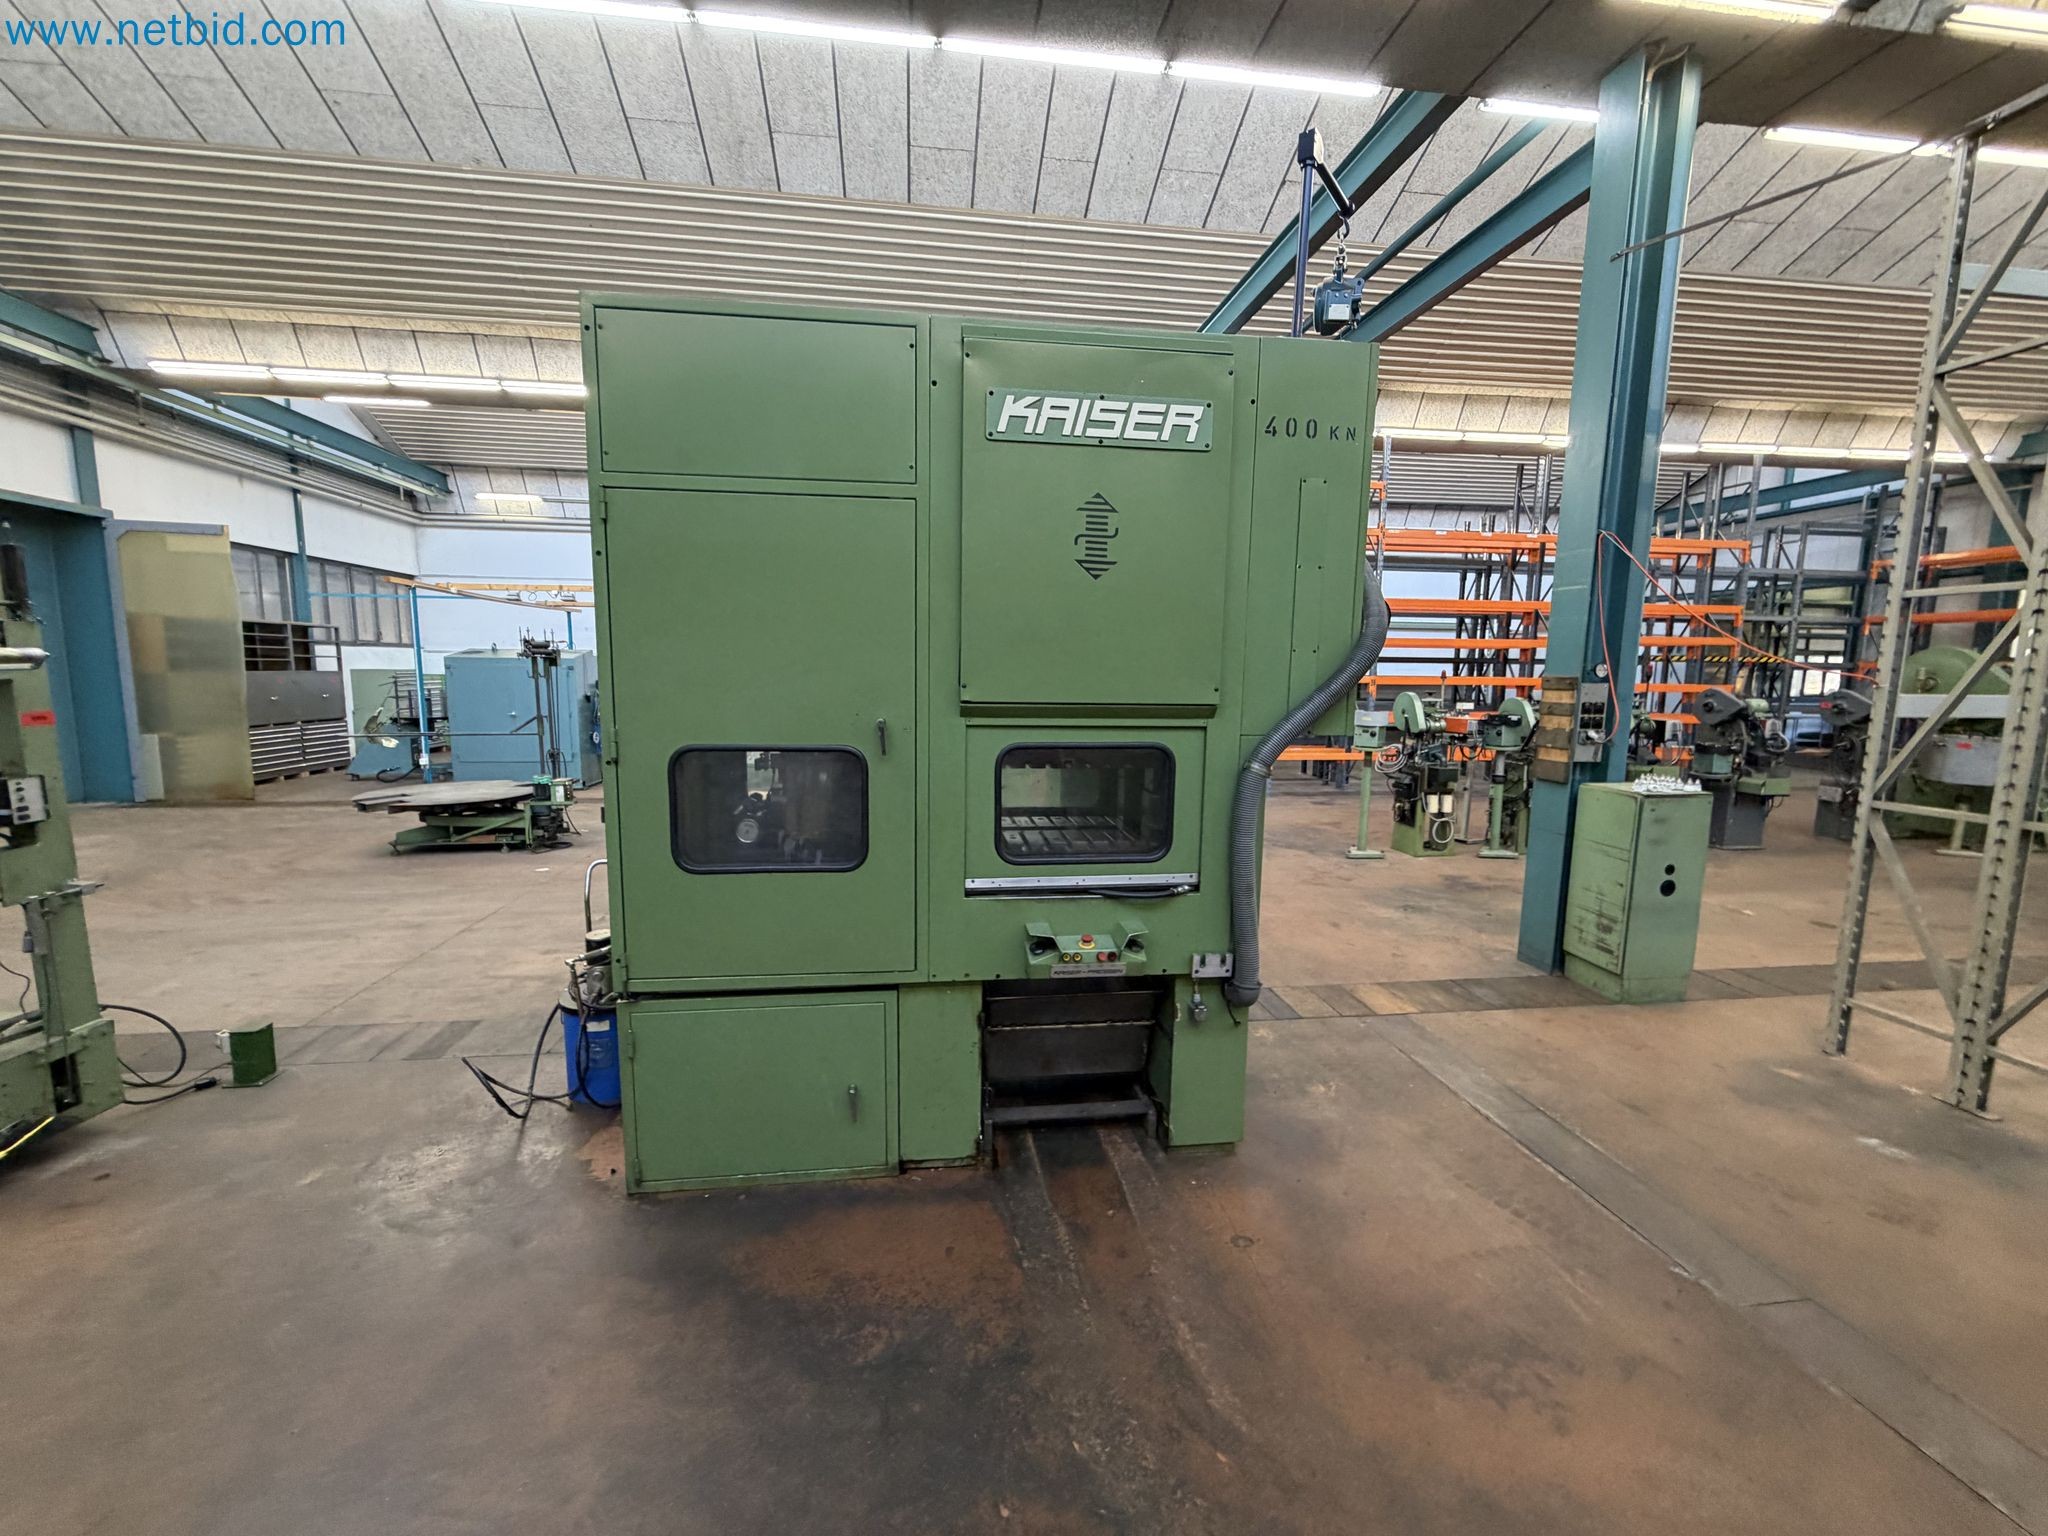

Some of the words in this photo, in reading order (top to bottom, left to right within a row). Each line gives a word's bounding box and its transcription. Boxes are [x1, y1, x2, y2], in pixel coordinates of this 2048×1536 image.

[997, 395, 1204, 443] KAISER
[1264, 416, 1318, 439] 400
[1329, 425, 1357, 441] KN
